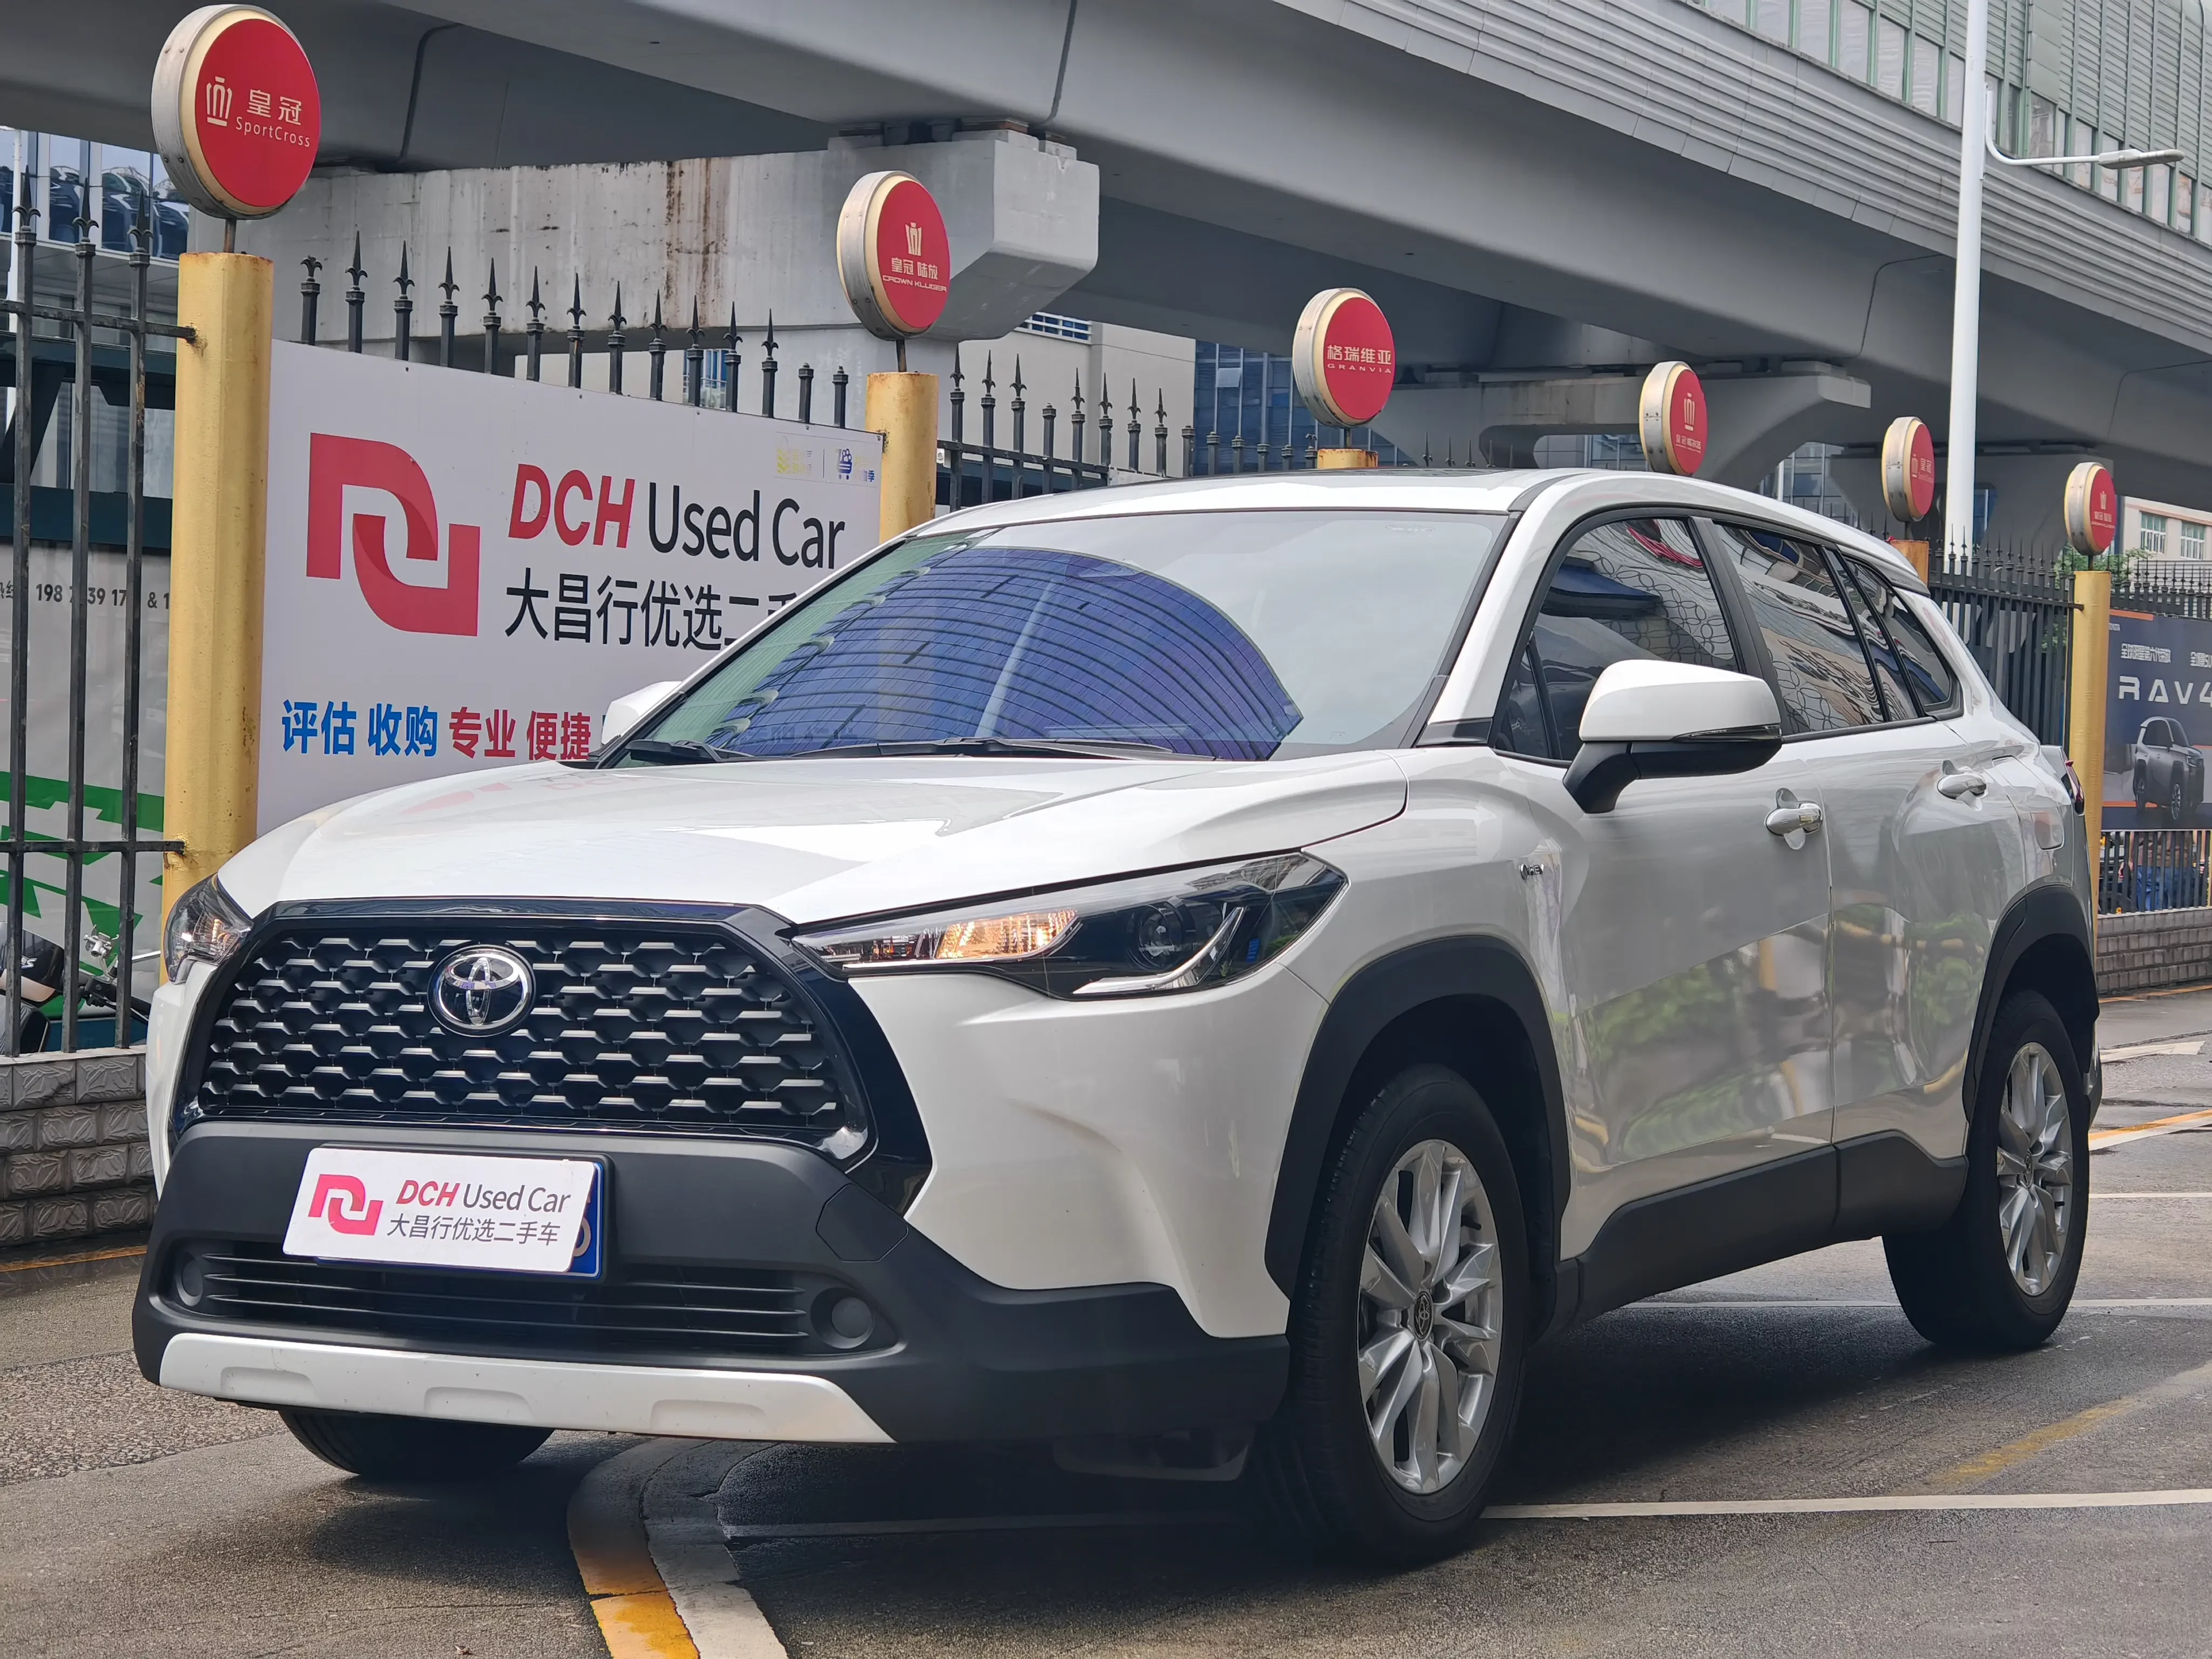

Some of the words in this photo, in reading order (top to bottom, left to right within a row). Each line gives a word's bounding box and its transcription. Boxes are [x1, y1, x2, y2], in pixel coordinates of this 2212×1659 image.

[247, 89, 302, 125] 皇冠
[235, 117, 311, 147] SportCross
[882, 275, 913, 286] CROWN
[915, 281, 947, 292] KLUGER
[891, 257, 914, 275] 皇冠
[917, 262, 938, 280] 陆放
[1327, 345, 1392, 365] 格瑞维亚
[1327, 363, 1392, 373] GRANVIA
[508, 464, 635, 548] DCH
[649, 482, 760, 562] Used
[773, 498, 845, 569] Car
[36, 584, 63, 602] 198
[2119, 676, 2212, 708] RAV4
[282, 699, 357, 756] 评估
[368, 703, 438, 757] 收购
[449, 706, 516, 759] 专业
[527, 710, 591, 761] 便捷
[396, 1179, 461, 1207] DCH
[463, 1184, 524, 1211] Used
[528, 1187, 571, 1213] Car
[387, 1213, 562, 1246] 大昌行优选二手车
